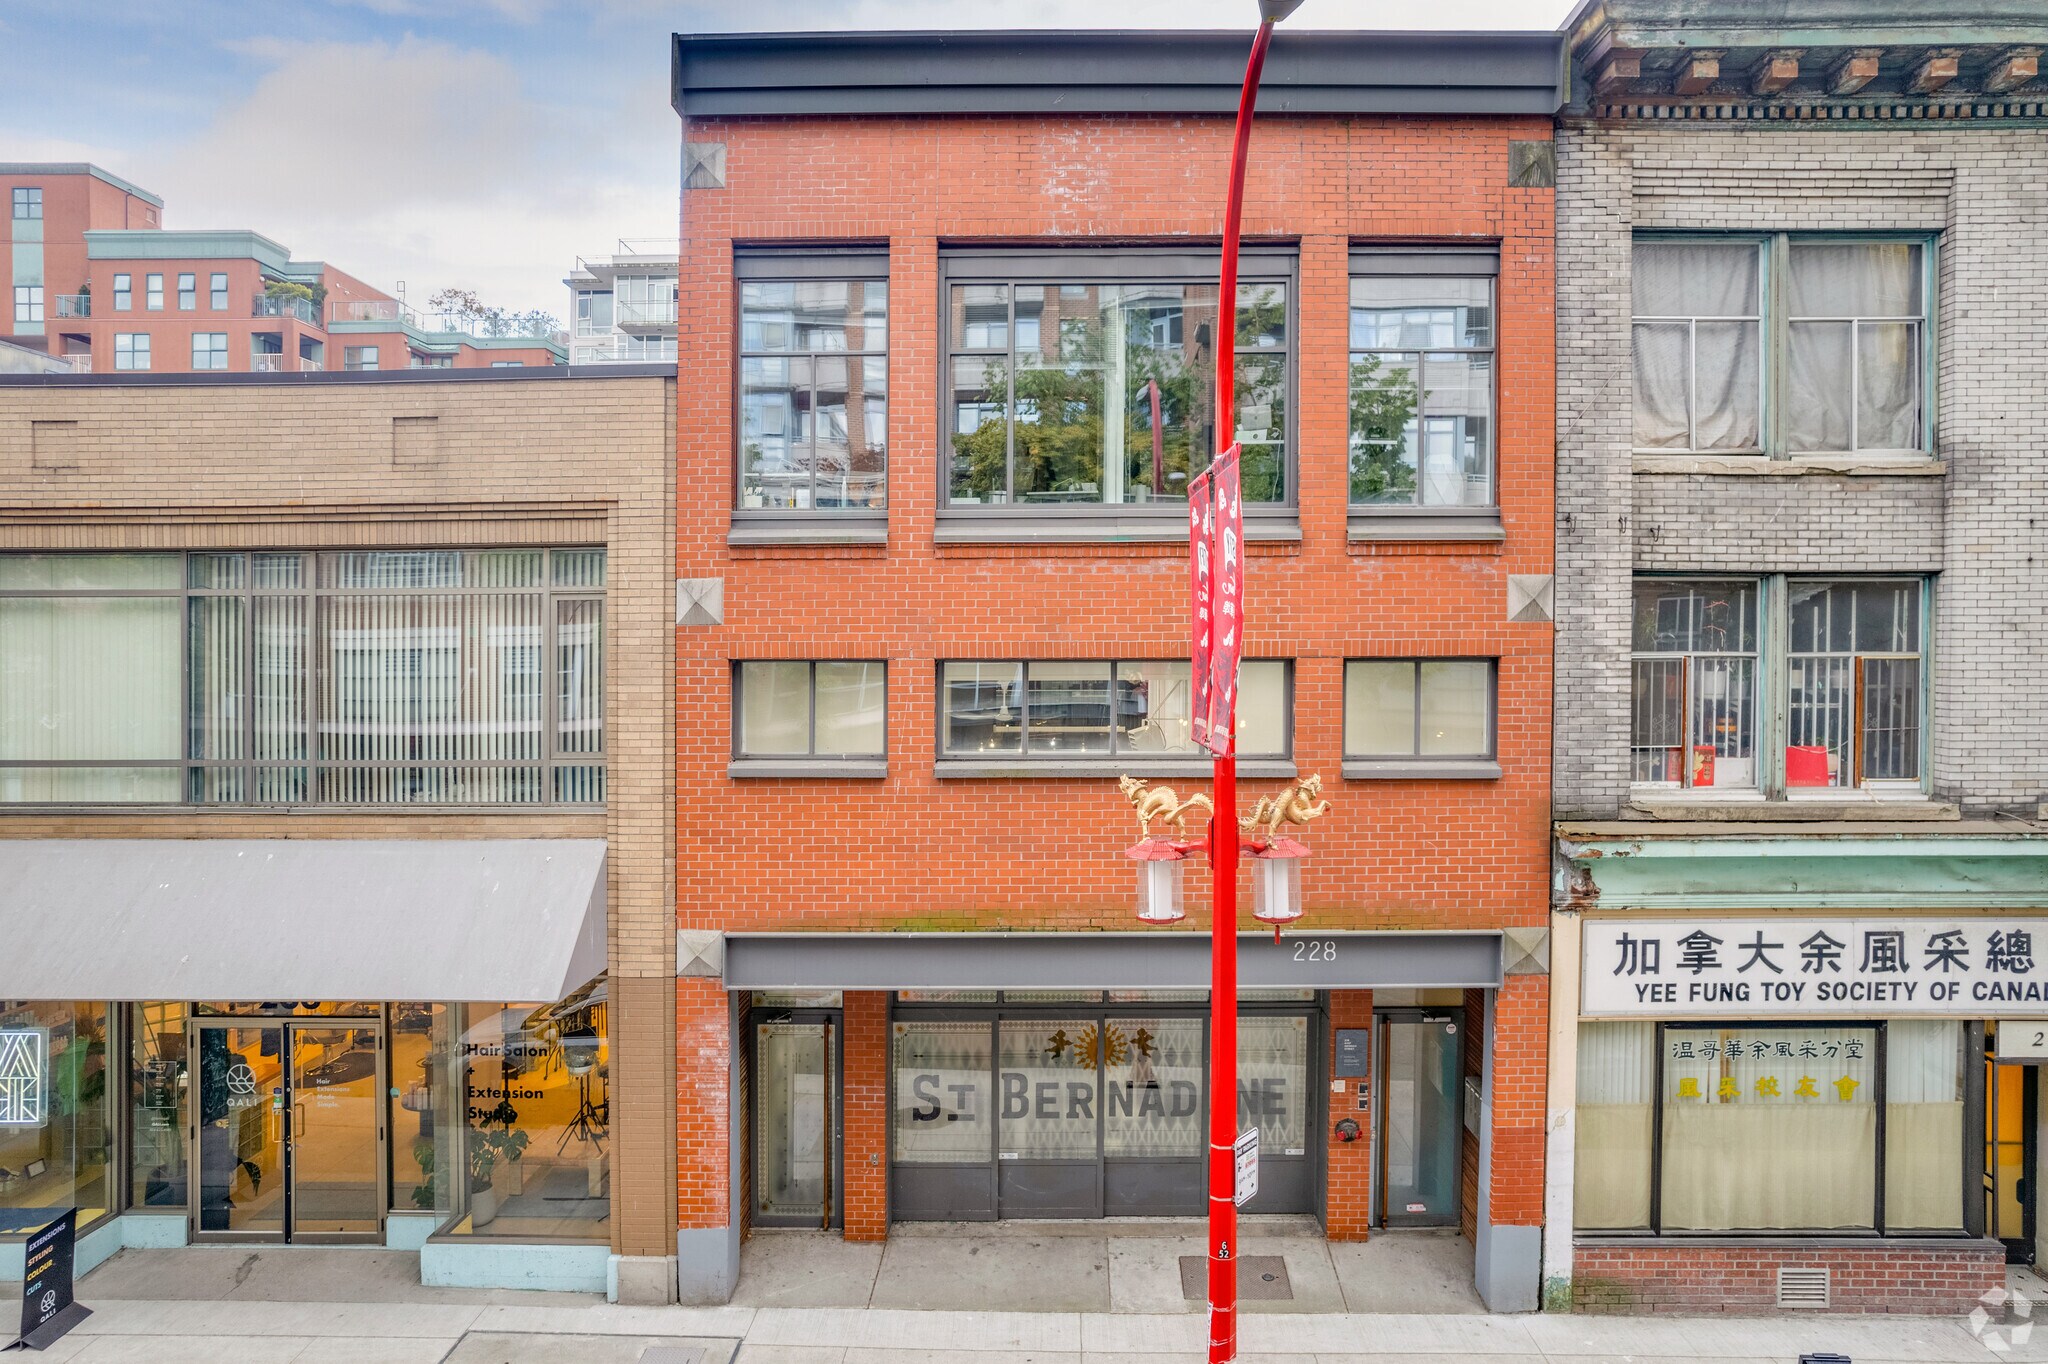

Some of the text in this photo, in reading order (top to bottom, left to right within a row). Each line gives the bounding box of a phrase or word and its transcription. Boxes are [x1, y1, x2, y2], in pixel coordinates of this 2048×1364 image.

[1293, 941, 1336, 961] 228
[1635, 983, 1677, 1003] YEE
[1689, 982, 1750, 1002] FUNG
[1761, 982, 1806, 1001] TOY
[1817, 981, 1918, 1001] SOCIETY
[1930, 981, 1960, 1001] OF
[2032, 1032, 2044, 1047] 2
[467, 1043, 548, 1057] Hair Salon
[467, 1085, 544, 1099] Extension
[1001, 1073, 1287, 1119] BERNADNE
[226, 1098, 258, 1107] QALI
[28, 1222, 66, 1252] EXTENSIONS
[1221, 1241, 1227, 1250] 6
[27, 1244, 54, 1267] STYLING
[1218, 1250, 1229, 1259] 52
[27, 1259, 53, 1281] COLOUR
[26, 1280, 42, 1296] CUTS
[40, 1307, 56, 1323] QALI
